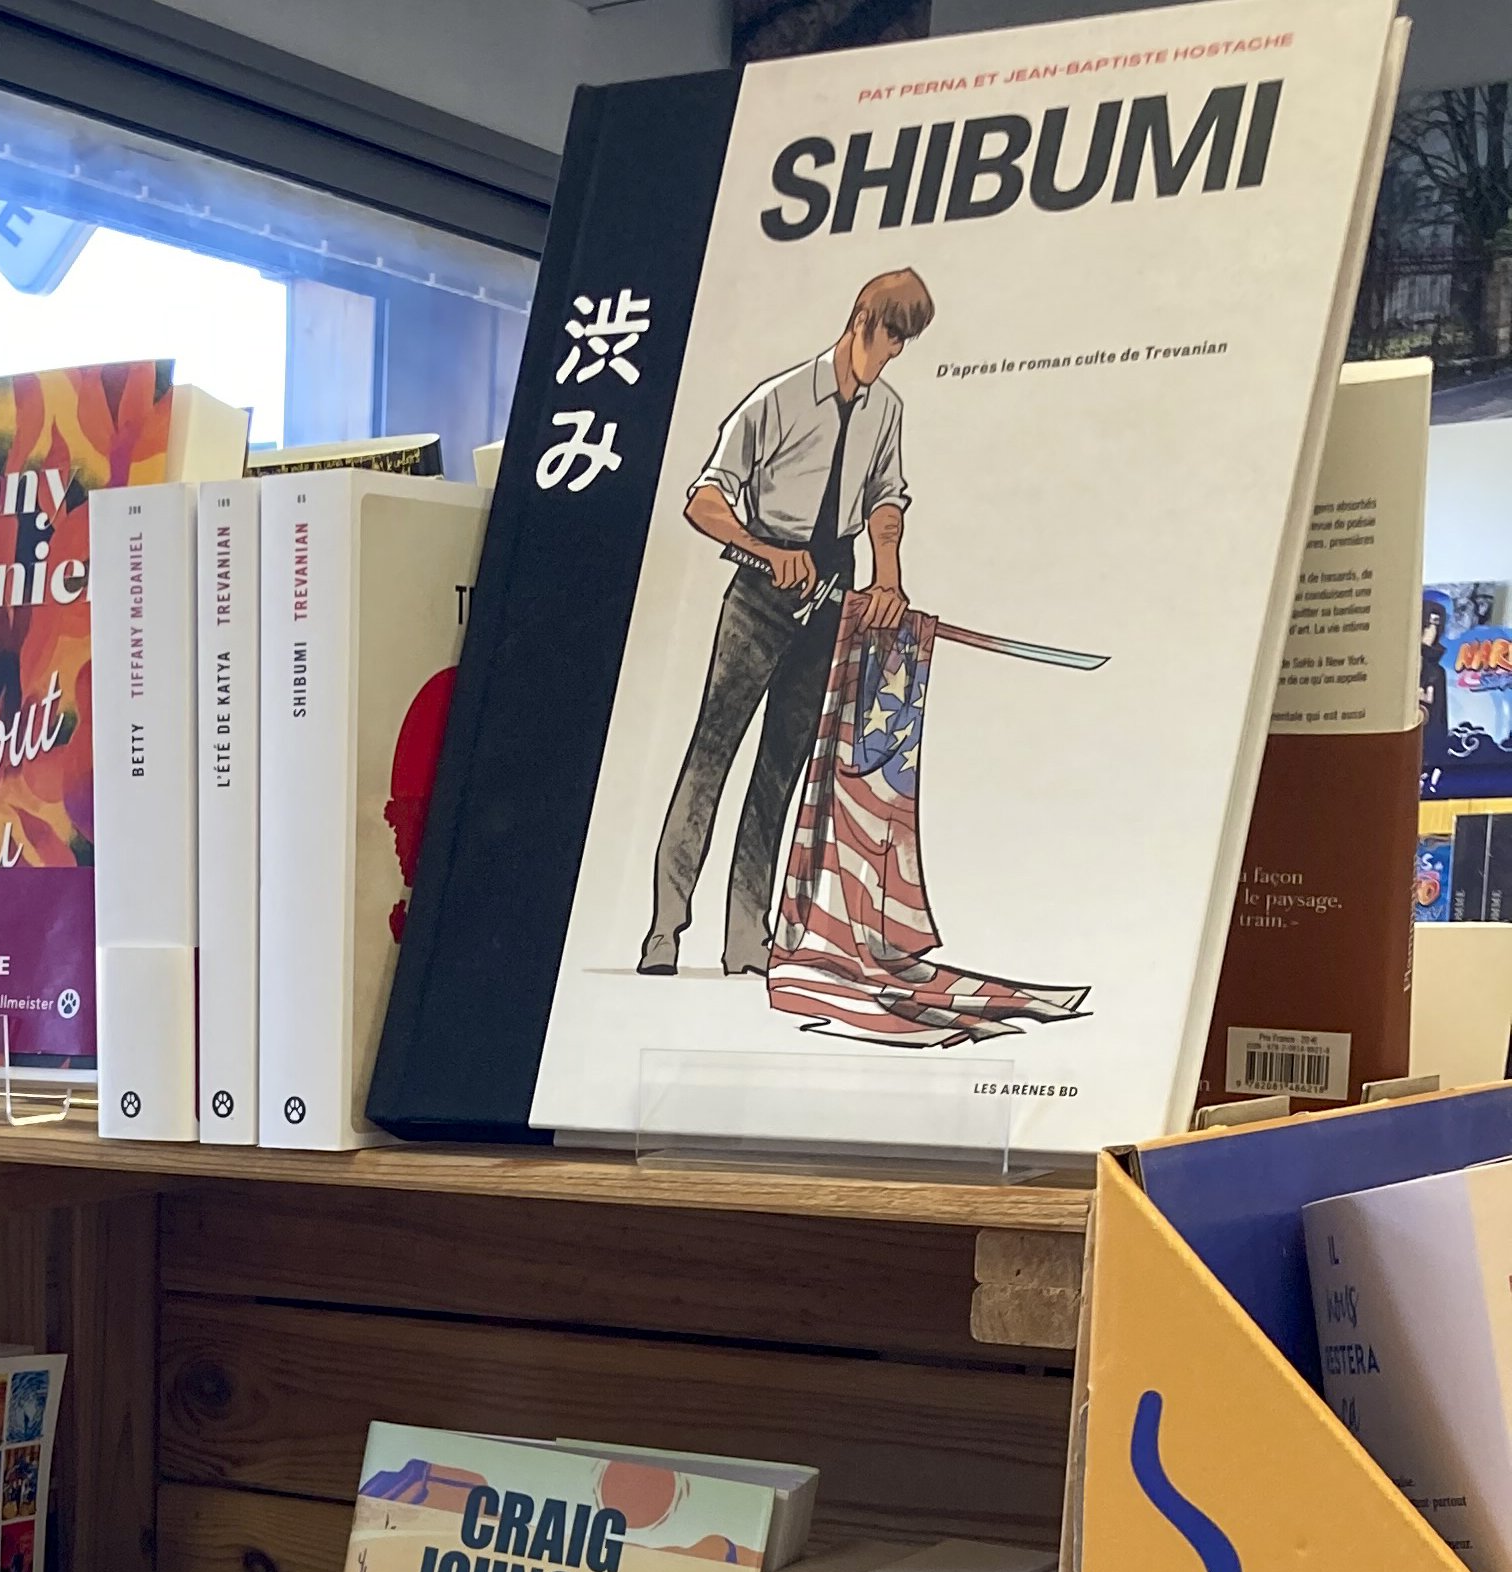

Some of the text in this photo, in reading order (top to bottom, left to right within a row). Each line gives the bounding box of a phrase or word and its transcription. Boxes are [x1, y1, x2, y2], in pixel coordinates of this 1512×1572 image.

[759, 79, 1284, 242] SHIBUMI
[859, 32, 1294, 103] PAT PERNA ET JEAN-BAPTISTE HOSTACHE
[534, 287, 651, 492] 渋み
[1001, 359, 1014, 373] le
[1018, 354, 1070, 371] roman
[1074, 350, 1115, 367] culte
[1121, 347, 1139, 362] de
[1145, 340, 1228, 360] Trevanian
[130, 532, 145, 778] BETTY TIFFANY McDANIEL
[213, 526, 230, 788] L'ÉTÉ DE KATYA TREVANIAN
[293, 521, 309, 718] SHIBUMI TREVANIAN
